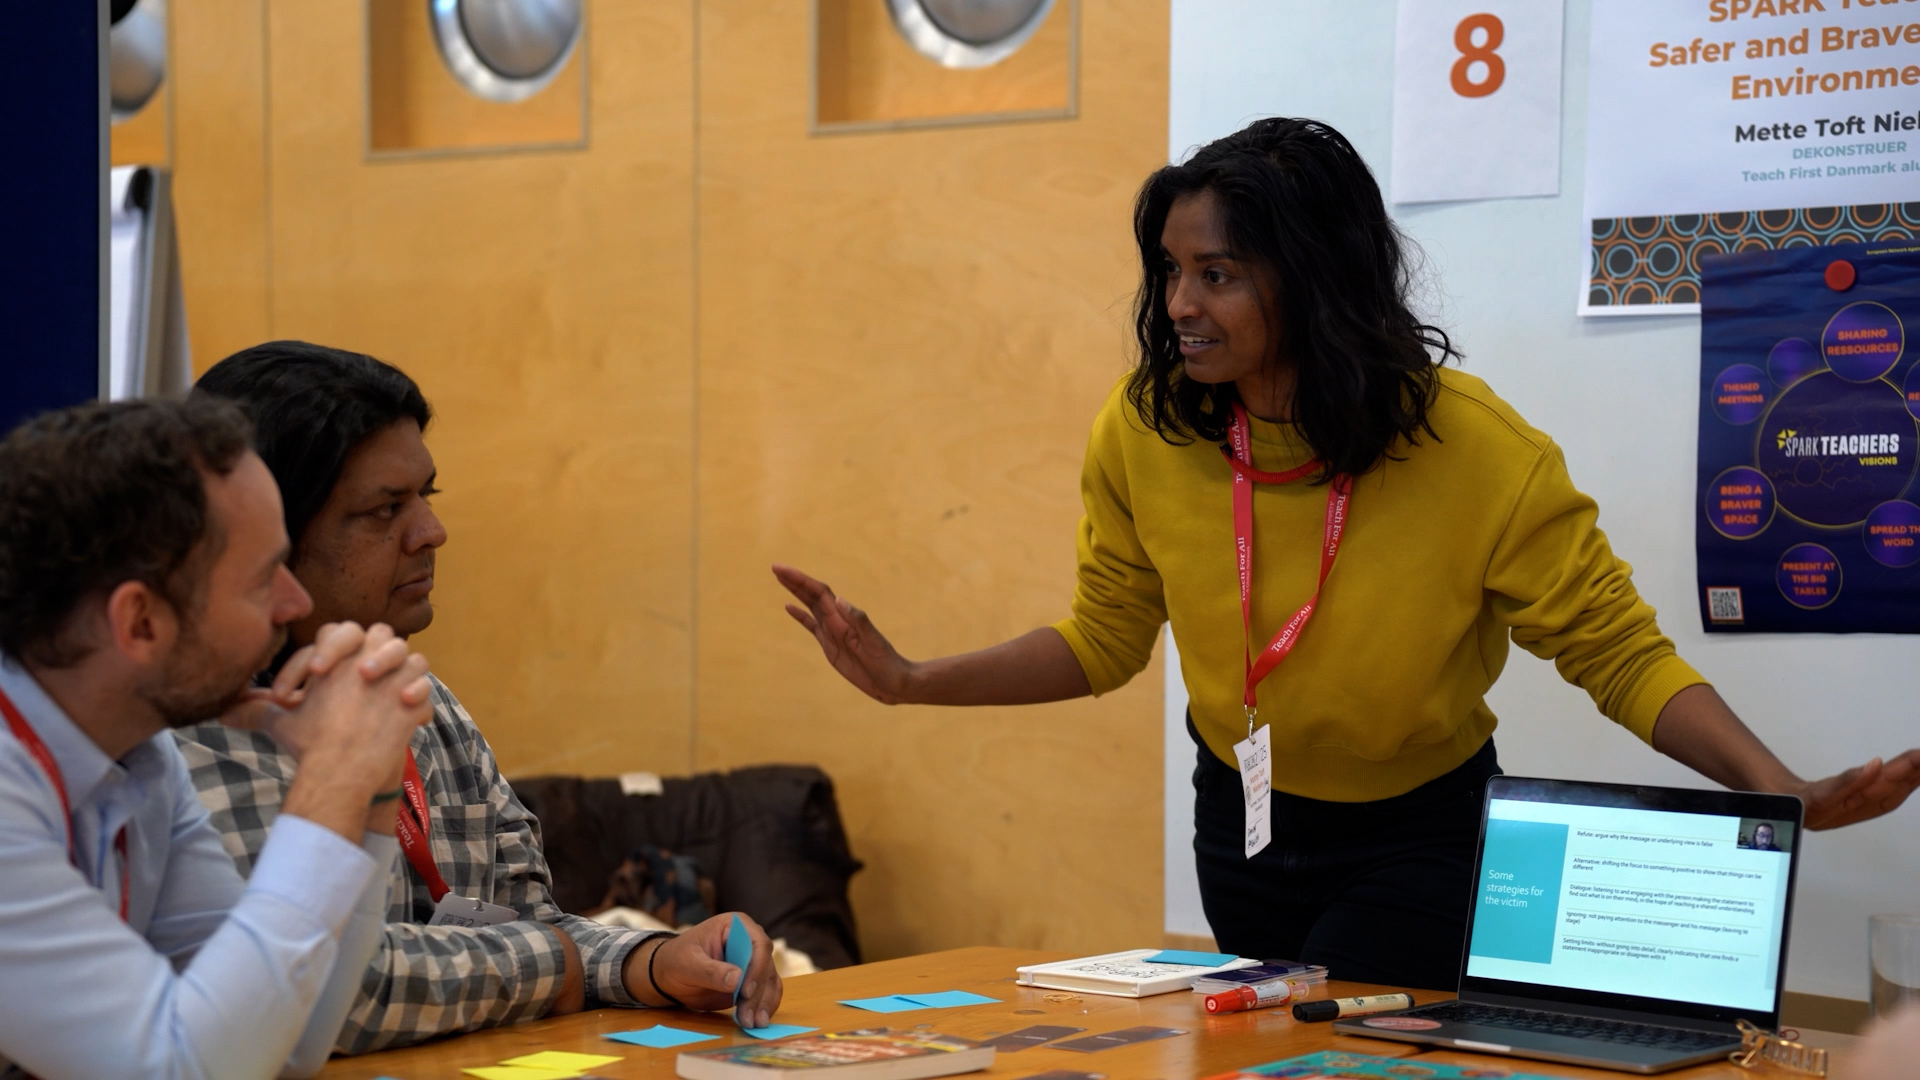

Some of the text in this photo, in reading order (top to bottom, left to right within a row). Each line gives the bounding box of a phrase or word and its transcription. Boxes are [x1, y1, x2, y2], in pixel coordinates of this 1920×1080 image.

[1649, 22, 1920, 68] Safer and Brave
[1450, 13, 1506, 98] 8
[1731, 65, 1920, 100] Environme
[1735, 122, 1807, 143] Mette
[1814, 115, 1866, 137] Toft
[1792, 141, 1907, 160] DEKONSTRUER
[1742, 169, 1785, 182] Teach
[1789, 166, 1822, 180] First
[1826, 161, 1896, 178] Danmark
[1837, 328, 1888, 340] SHARING
[1827, 342, 1898, 356] RESSOURCES
[1723, 382, 1760, 392] THEMED
[1718, 394, 1763, 404] MEETINGS
[1234, 433, 1242, 451] For
[1785, 433, 1900, 457] SPARK TEACHERS
[1859, 456, 1898, 466] VISIONS
[1720, 485, 1762, 496] BEING A
[1334, 494, 1346, 523] Teach
[1720, 499, 1762, 510] BRAVER
[1723, 514, 1758, 525] SPACE
[1333, 525, 1342, 541] For
[1870, 525, 1907, 534] SPREAD
[1237, 536, 1245, 552] All
[1883, 538, 1914, 546] WORD
[1782, 562, 1835, 571] PRESENT AT
[1792, 574, 1827, 583] THE BIG
[1794, 586, 1827, 596] TABLES
[1271, 605, 1312, 652] Teach For All
[403, 780, 416, 793] All
[1488, 869, 1514, 880] Some
[1650, 864, 1675, 873] something
[1486, 884, 1544, 896] strategies for
[1593, 886, 1613, 894] listening
[1631, 890, 1652, 898] engaging
[1485, 895, 1528, 907] the victim
[1674, 901, 1695, 909] reaching
[1718, 905, 1754, 915] understanding
[1653, 920, 1680, 928] messenger
[1657, 949, 1673, 957] clearly
[1674, 950, 1699, 958] indicating
